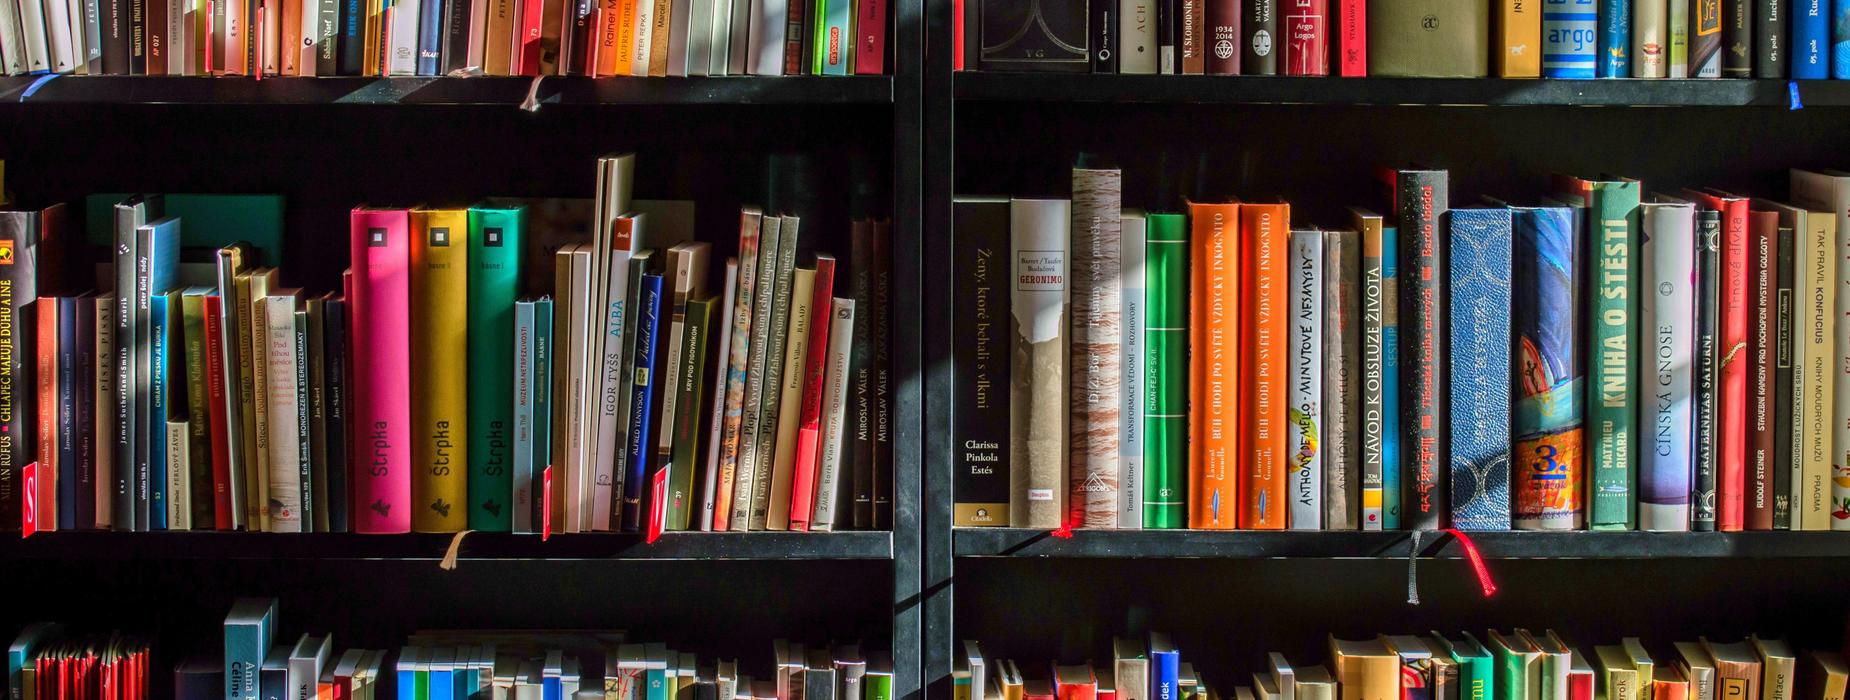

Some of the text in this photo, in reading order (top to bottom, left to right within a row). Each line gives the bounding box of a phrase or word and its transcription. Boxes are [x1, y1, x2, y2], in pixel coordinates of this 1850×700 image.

[604, 12, 616, 46] Rainer
[622, 1, 631, 27] RUDEL
[1137, 4, 1146, 33] ACH
[1296, 23, 1313, 31] Argo
[637, 13, 647, 60] PETER REPKA
[1184, 47, 1192, 57] M.
[1294, 32, 1315, 40] Logos
[1548, 28, 1594, 51] argo
[1089, 216, 1102, 257] pravěku
[1422, 224, 1433, 257] Bardo
[1817, 229, 1826, 248] TAK
[1020, 275, 1062, 284] GERONIMO
[1089, 260, 1100, 280] svět
[1728, 217, 1742, 312] Trnová dívka
[1816, 250, 1825, 284] PRAVIL
[1760, 269, 1768, 306] MYSTERIA
[238, 298, 248, 331] smutku
[797, 304, 806, 333] BALADY
[1128, 302, 1136, 345] ROZHOVORY
[1210, 213, 1223, 415] CHODÍ PO VŽDYCKY INKOGNITO
[1258, 213, 1270, 415] CHODÍ PO VŽDYCKY INKOGNITO
[1421, 287, 1434, 330] mrtvých
[1601, 219, 1627, 408] KNIHA O ŠTĚSTÍ
[1815, 287, 1824, 345] KONFUCIUS
[977, 322, 991, 361] behali
[1758, 307, 1767, 348] POCHOPENÍ
[154, 347, 161, 355] JE
[606, 300, 623, 416] IGOR TYŠŠ ALBA
[1090, 354, 1099, 373] Bor
[1387, 327, 1397, 367] SESTUP
[1422, 332, 1432, 363] kniha
[1759, 349, 1767, 364] PRO
[1126, 354, 1135, 384] VĚDOMÍ
[1299, 256, 1313, 506] ANTHONY DE MELLO MINUTOVÉ NESMYSLY
[1365, 266, 1379, 464] NÁVOD K OBSLUZE ŽIVOTA
[1757, 365, 1766, 396] KAMENY
[1815, 356, 1823, 383] KNIHY
[977, 373, 991, 409] vlkmi
[1088, 377, 1099, 388] Z.
[1088, 390, 1099, 403] D.
[1655, 325, 1672, 457] ČÍNSKÁ GNOSE
[858, 397, 868, 441] MIROSLAV
[878, 398, 887, 442] MIROSLAV
[1127, 386, 1135, 443] TRANSFORMACE
[1700, 334, 1711, 476] FRATERNITAS SATURNI
[1814, 385, 1823, 435] MOUDRÝCH
[119, 420, 128, 444] James
[632, 391, 644, 456] ALFRED TENNYSON
[744, 409, 756, 436] Plop!
[762, 409, 775, 435] Plop!
[1338, 368, 1348, 490] ANTHONY DE MELLO
[368, 421, 391, 477] Štrpka
[428, 421, 453, 476] Štrpka
[482, 421, 506, 476] Štrpka
[740, 441, 752, 481] Wernisch
[758, 440, 771, 480] Wernisch
[826, 444, 834, 461] Vian
[965, 440, 999, 449] Clarissa
[965, 452, 998, 462] Pinkola
[1532, 444, 1567, 472] 3.
[1602, 420, 1613, 469] MATTHIEU
[1616, 432, 1626, 469] RICARD
[824, 464, 832, 484] Boris
[971, 465, 993, 475] Estés
[1757, 449, 1765, 480] STEINER
[675, 491, 682, 499] 39
[739, 482, 748, 501] Ivan
[756, 481, 765, 500] Ivan
[1126, 490, 1134, 512] Tomáš
[1756, 481, 1765, 509] RUDOLF
[1813, 475, 1821, 512] PRAGMA
[230, 661, 242, 698] Céline
[245, 661, 255, 692] Anna
